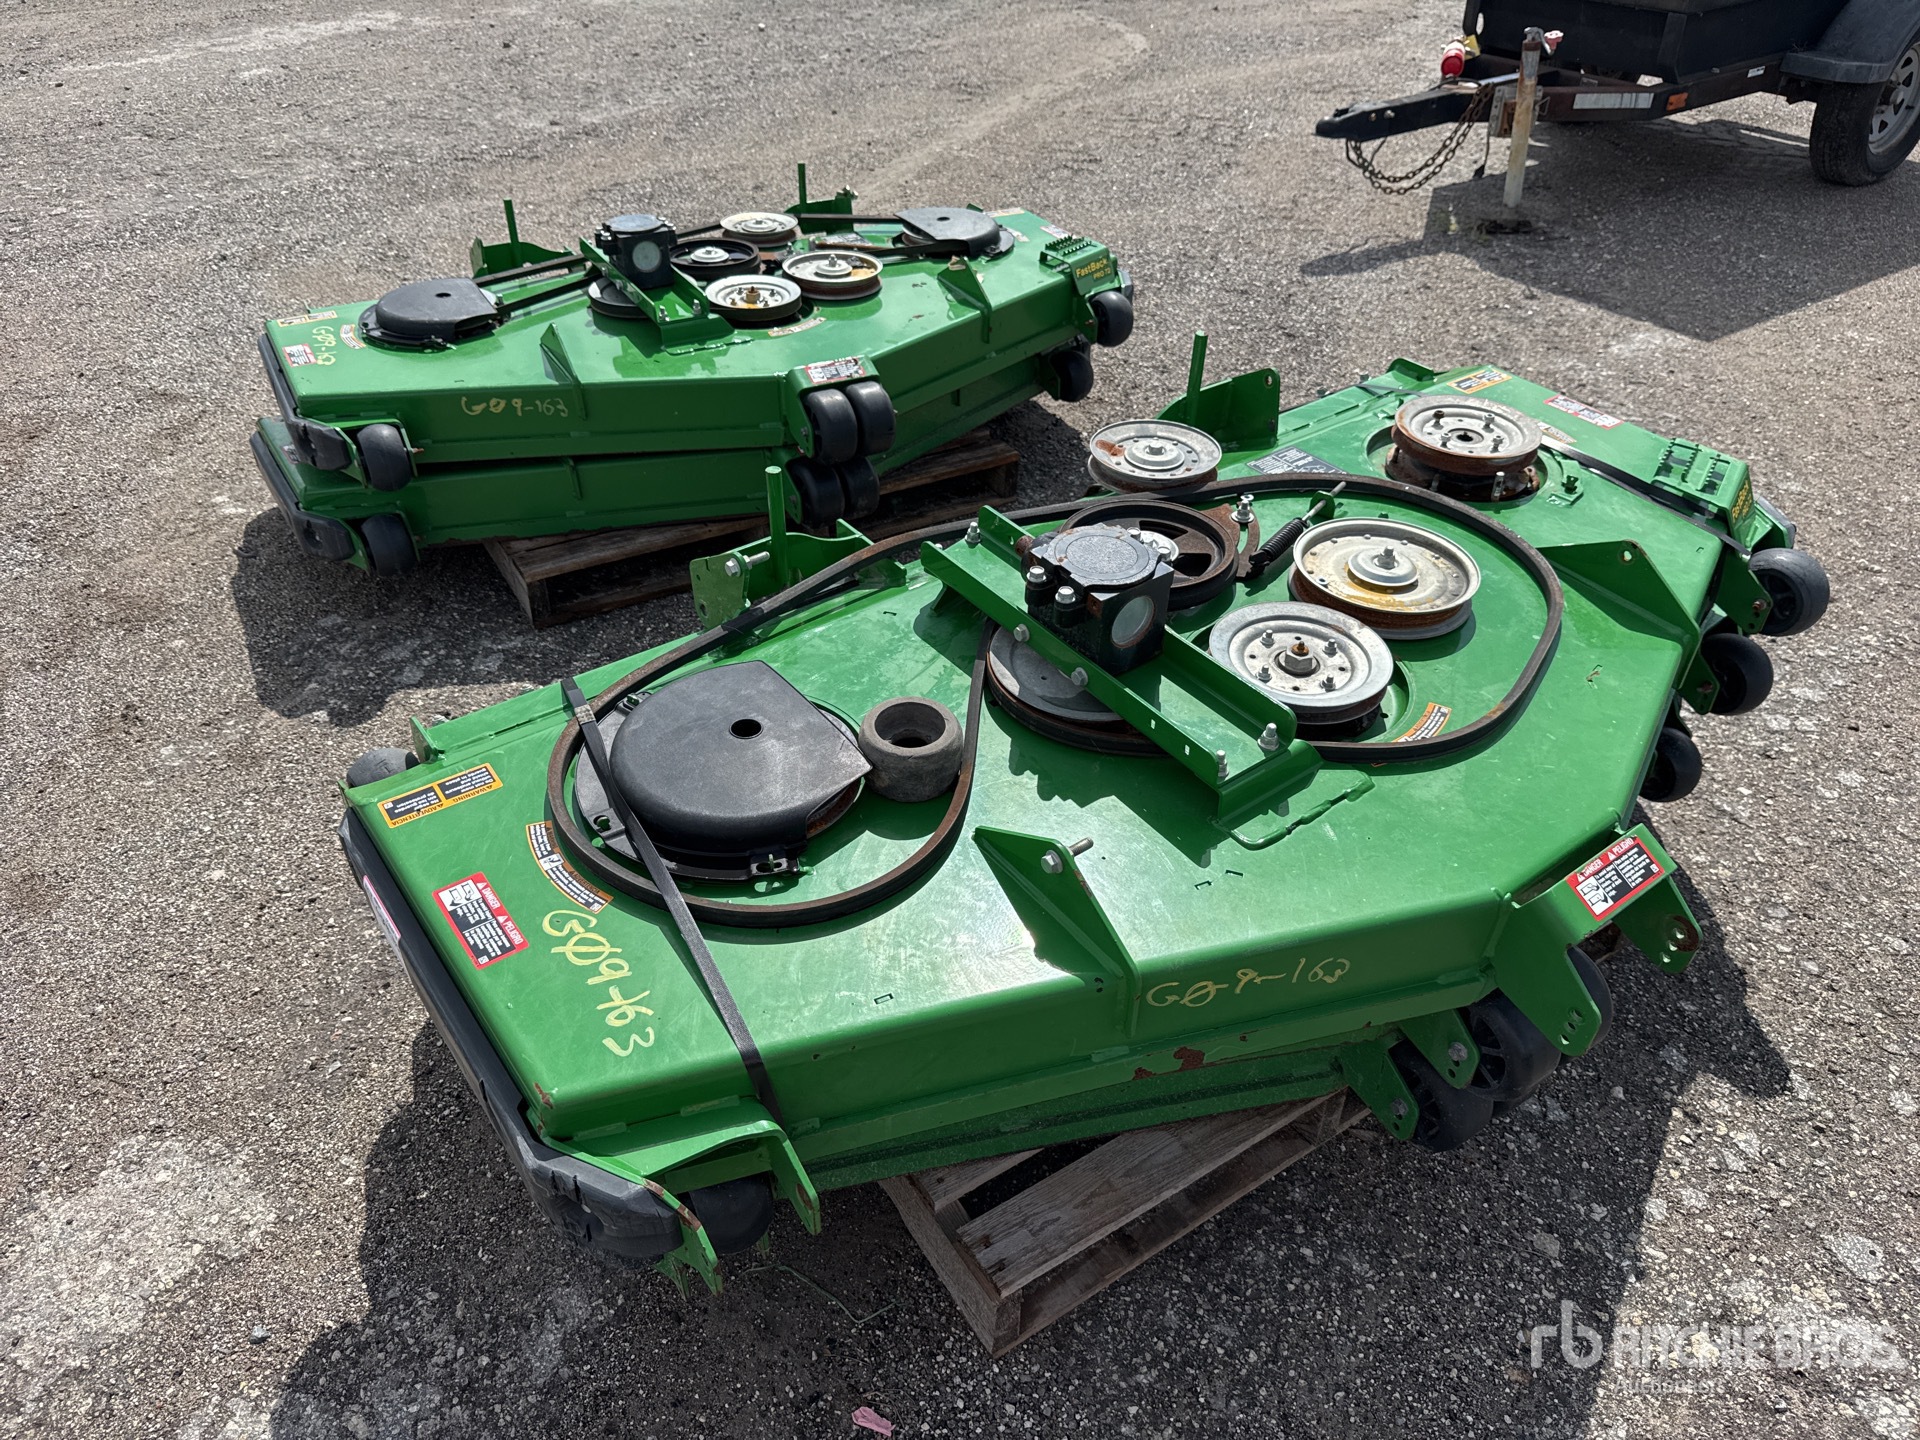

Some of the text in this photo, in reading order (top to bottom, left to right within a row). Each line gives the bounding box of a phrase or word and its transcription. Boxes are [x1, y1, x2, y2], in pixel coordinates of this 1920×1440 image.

[1076, 258, 1107, 278] FastBack
[451, 786, 486, 803] WARNING
[391, 805, 437, 827] ADVERTENCIA
[480, 886, 502, 910] DANGER
[501, 919, 524, 945] PELIGRO
